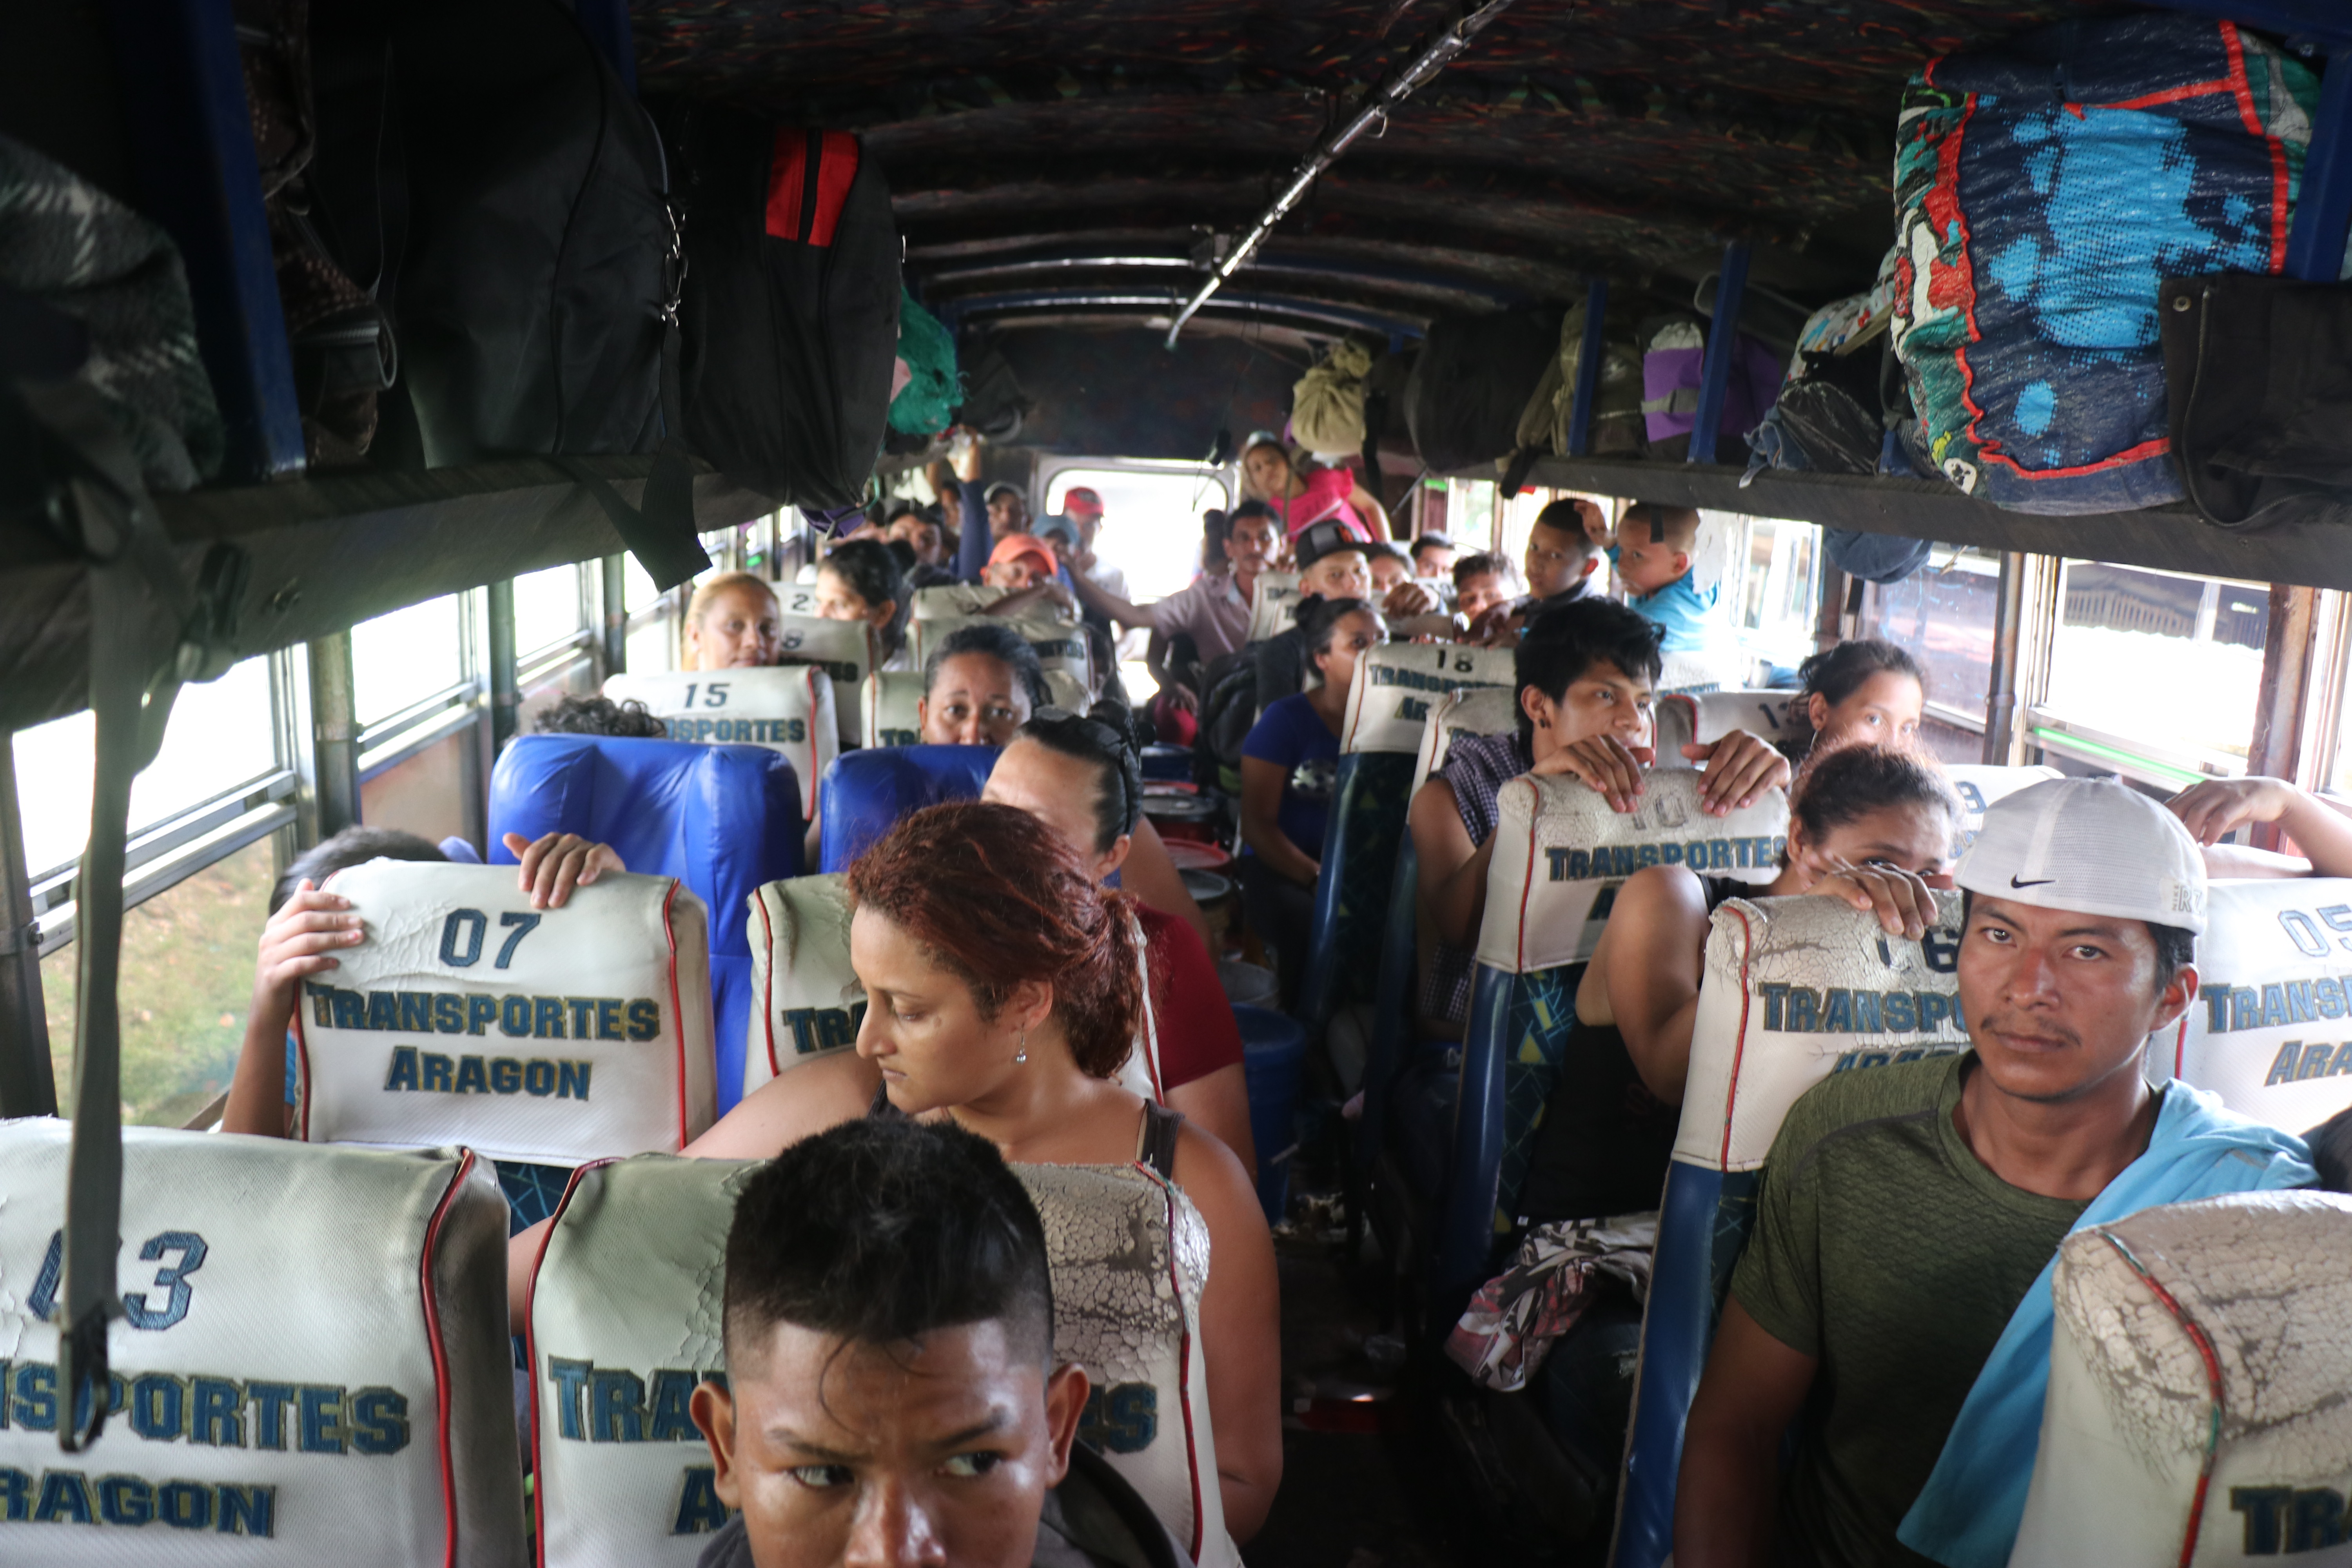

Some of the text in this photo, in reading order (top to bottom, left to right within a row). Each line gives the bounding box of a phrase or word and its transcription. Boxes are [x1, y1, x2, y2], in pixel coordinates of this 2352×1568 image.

[1369, 664, 1509, 694] TRANSP
[1437, 649, 1473, 672] 18
[685, 682, 730, 708] 15
[439, 907, 543, 969] 07
[2277, 904, 2352, 957] 05
[306, 981, 661, 1042] TRANSPORTES
[383, 1045, 592, 1101] ARAGON
